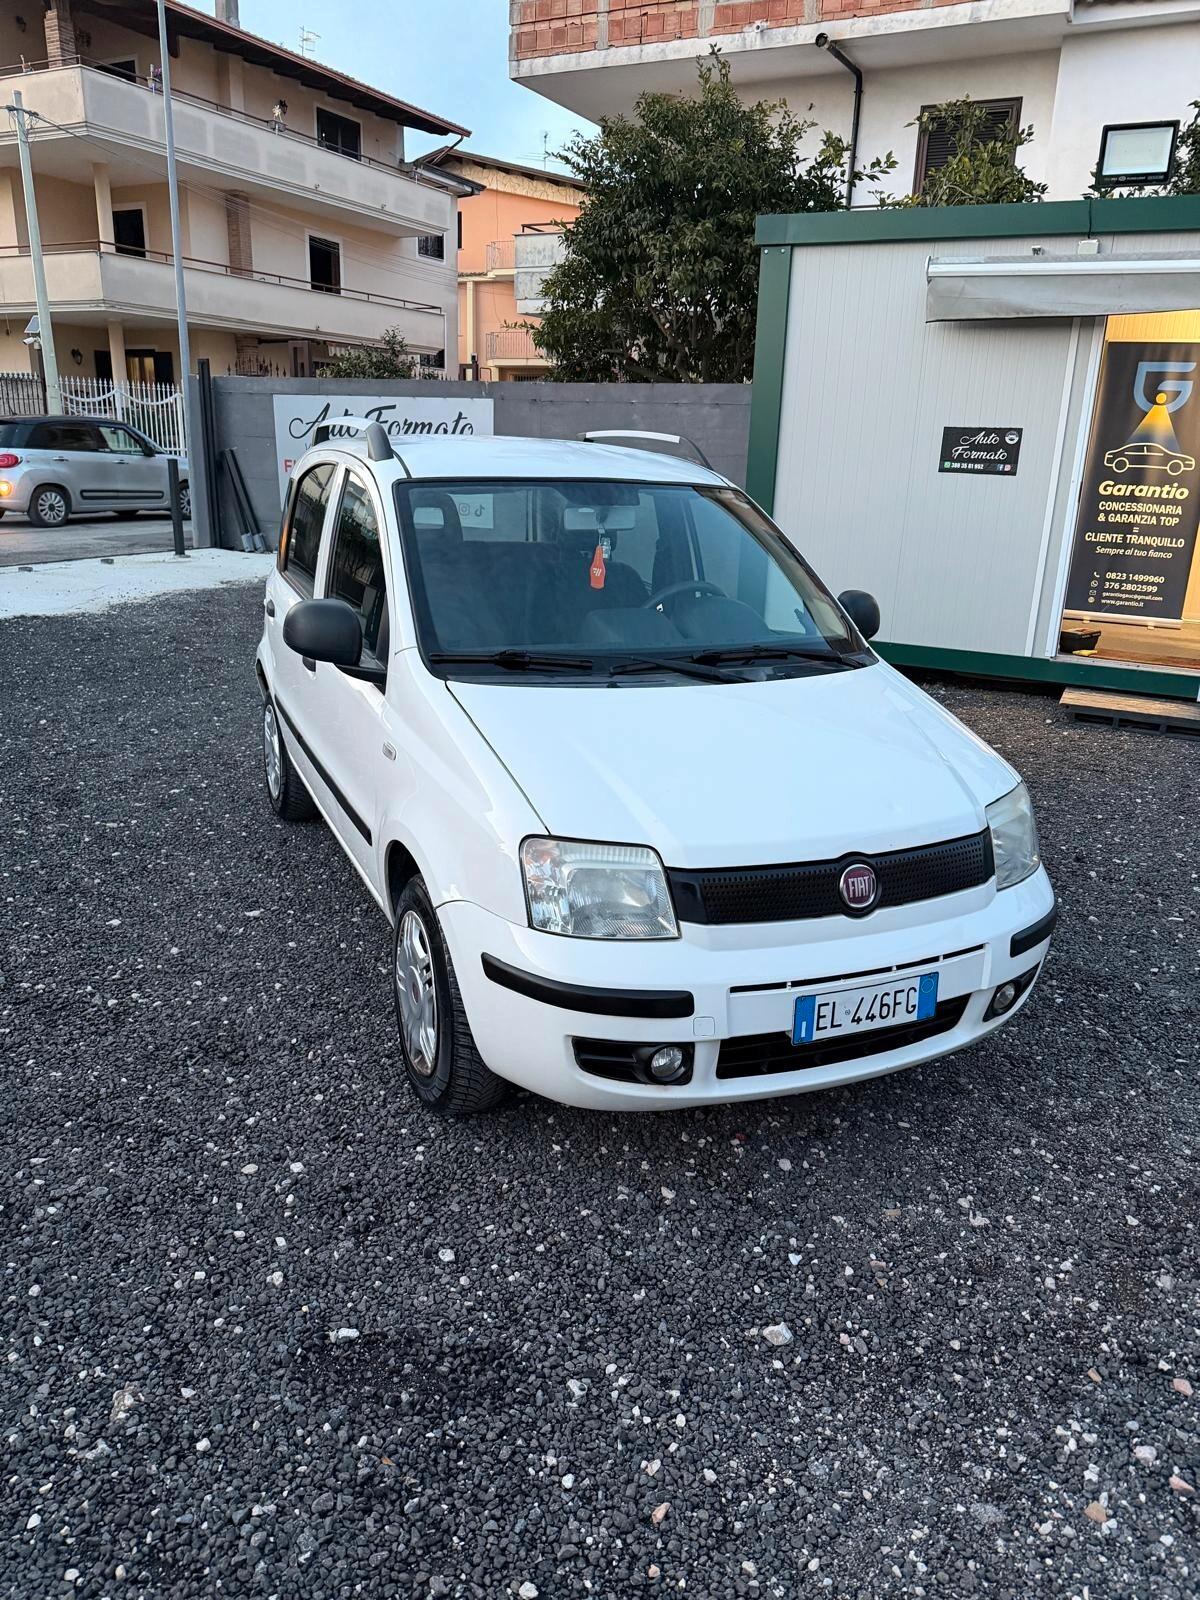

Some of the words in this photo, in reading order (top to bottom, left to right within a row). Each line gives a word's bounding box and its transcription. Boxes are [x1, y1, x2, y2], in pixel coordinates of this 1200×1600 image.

[960, 431, 1000, 445] Auto
[952, 446, 1008, 460] Formato
[1098, 480, 1189, 500] Garantio
[1098, 501, 1183, 515] CONCESSIONARIA
[1098, 512, 1106, 522] &
[1108, 514, 1157, 525] GARANZIA
[1160, 516, 1180, 527] TOP
[1085, 532, 1124, 543] CLIENTE
[1126, 534, 1185, 548] TRANQUILLO
[1095, 546, 1124, 556] Sempre
[1125, 547, 1133, 556] al
[1134, 548, 1147, 557] tuo
[1148, 549, 1173, 559] fianco
[1105, 571, 1127, 580] 0823
[1128, 573, 1165, 584] 1499960
[1104, 581, 1120, 590] 376
[1121, 583, 1158, 593] 2802599
[1101, 599, 1144, 607] www.garantio.it
[848, 875, 871, 898] FIAT
[815, 1000, 842, 1032] EL
[850, 986, 918, 1025] 446FG
